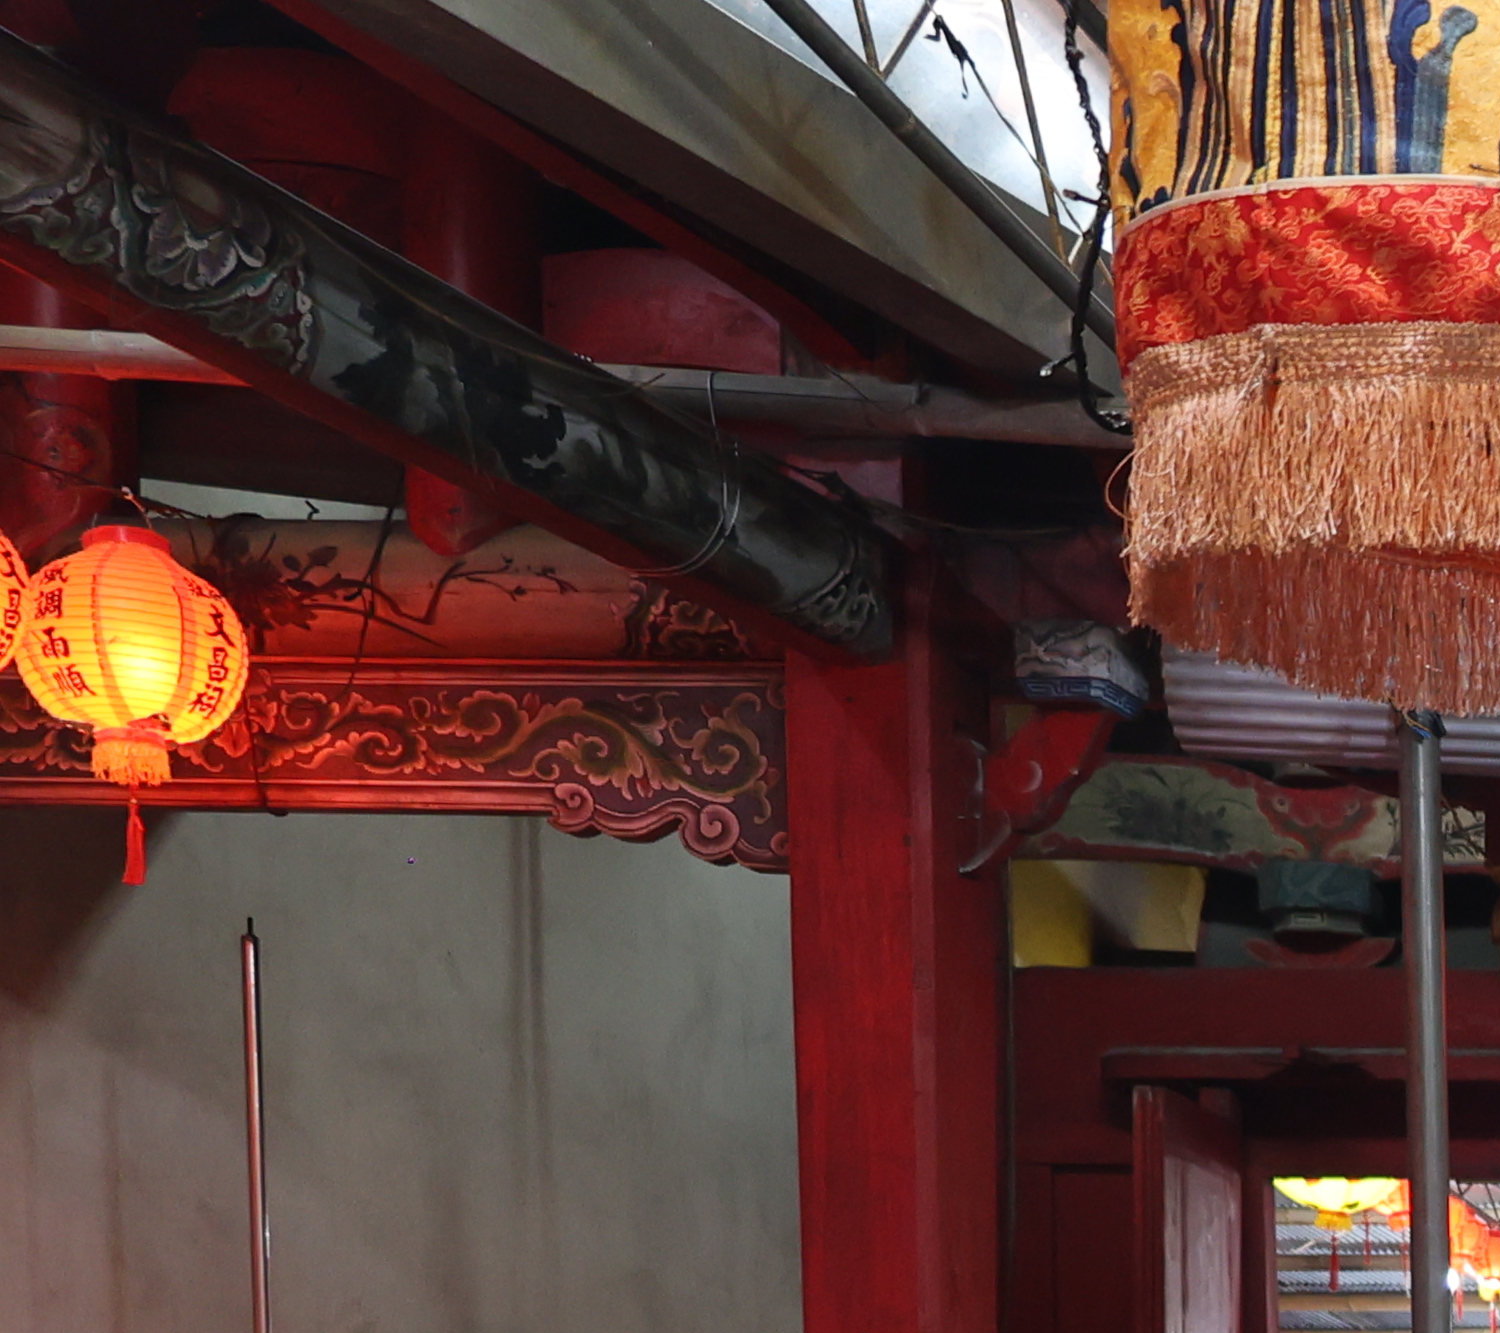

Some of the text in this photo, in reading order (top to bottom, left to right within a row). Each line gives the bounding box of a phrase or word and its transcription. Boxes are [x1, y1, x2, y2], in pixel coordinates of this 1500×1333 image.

[34, 562, 97, 697] 風調雨順
[188, 604, 236, 719] 文昌祠
